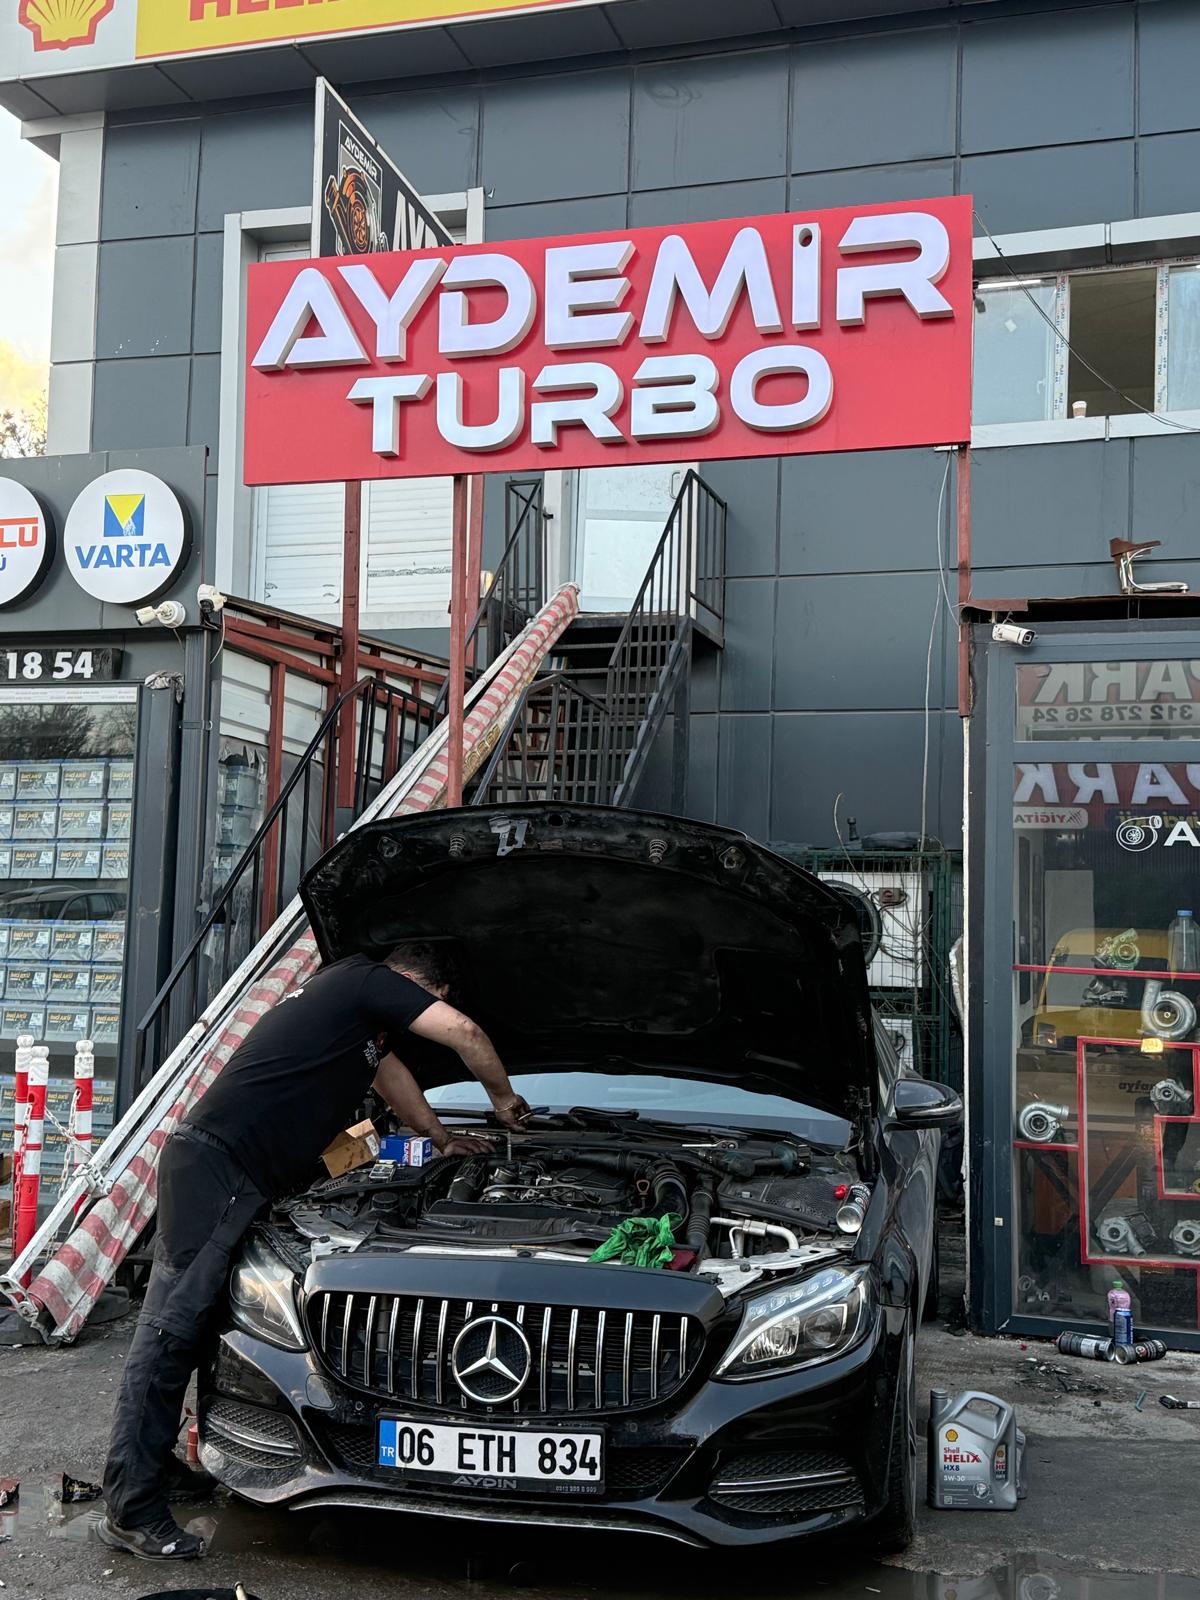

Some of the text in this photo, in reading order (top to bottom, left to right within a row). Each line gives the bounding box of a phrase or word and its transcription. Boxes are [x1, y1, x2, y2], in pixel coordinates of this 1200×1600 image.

[346, 345, 834, 458] TURBO
[75, 543, 171, 569] VARTA
[6, 651, 94, 679] 18 54
[381, 1446, 394, 1457] TR
[398, 1426, 598, 1476] 06 ETH 834
[943, 1452, 982, 1463] HELIX
